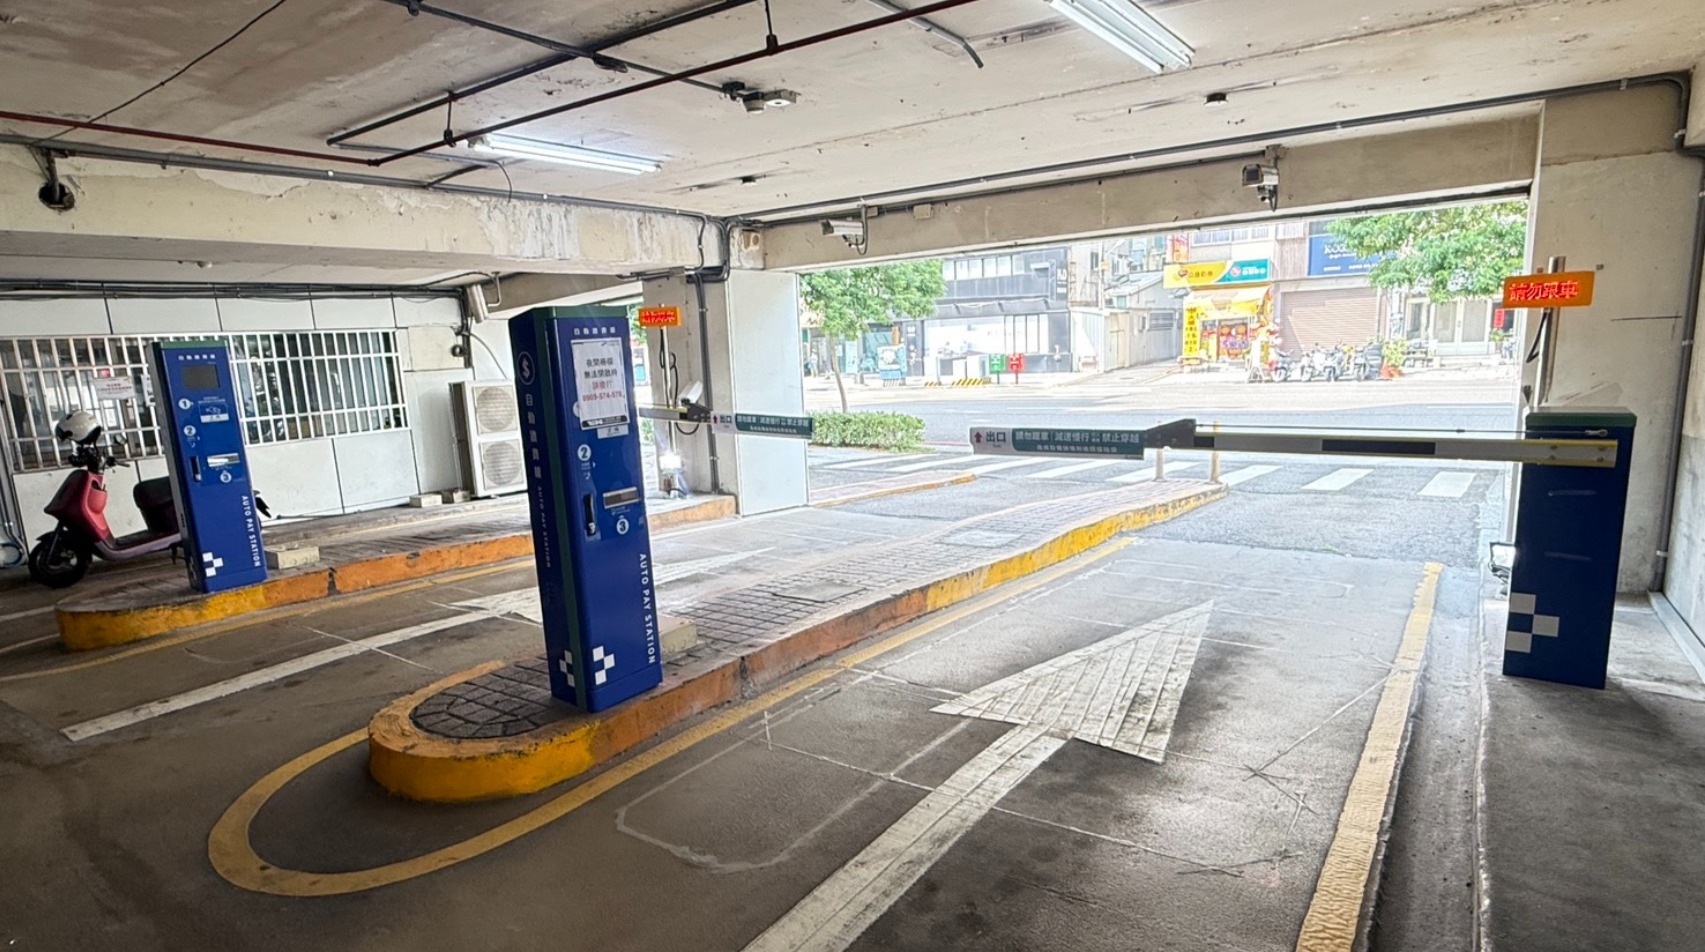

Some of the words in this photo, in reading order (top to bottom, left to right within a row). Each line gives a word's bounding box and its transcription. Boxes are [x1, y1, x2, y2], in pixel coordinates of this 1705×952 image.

[1509, 280, 1579, 301] 請勿跟車
[985, 430, 1008, 443] 出口
[1101, 432, 1140, 444] 禁止穿越
[580, 446, 588, 459] 2
[241, 495, 252, 517] AUTO
[246, 518, 255, 532] PAY
[618, 520, 626, 532] 3
[248, 534, 262, 567] STATION
[639, 553, 649, 585] AUTO
[643, 589, 652, 610] PAY
[644, 614, 656, 664] STATION
